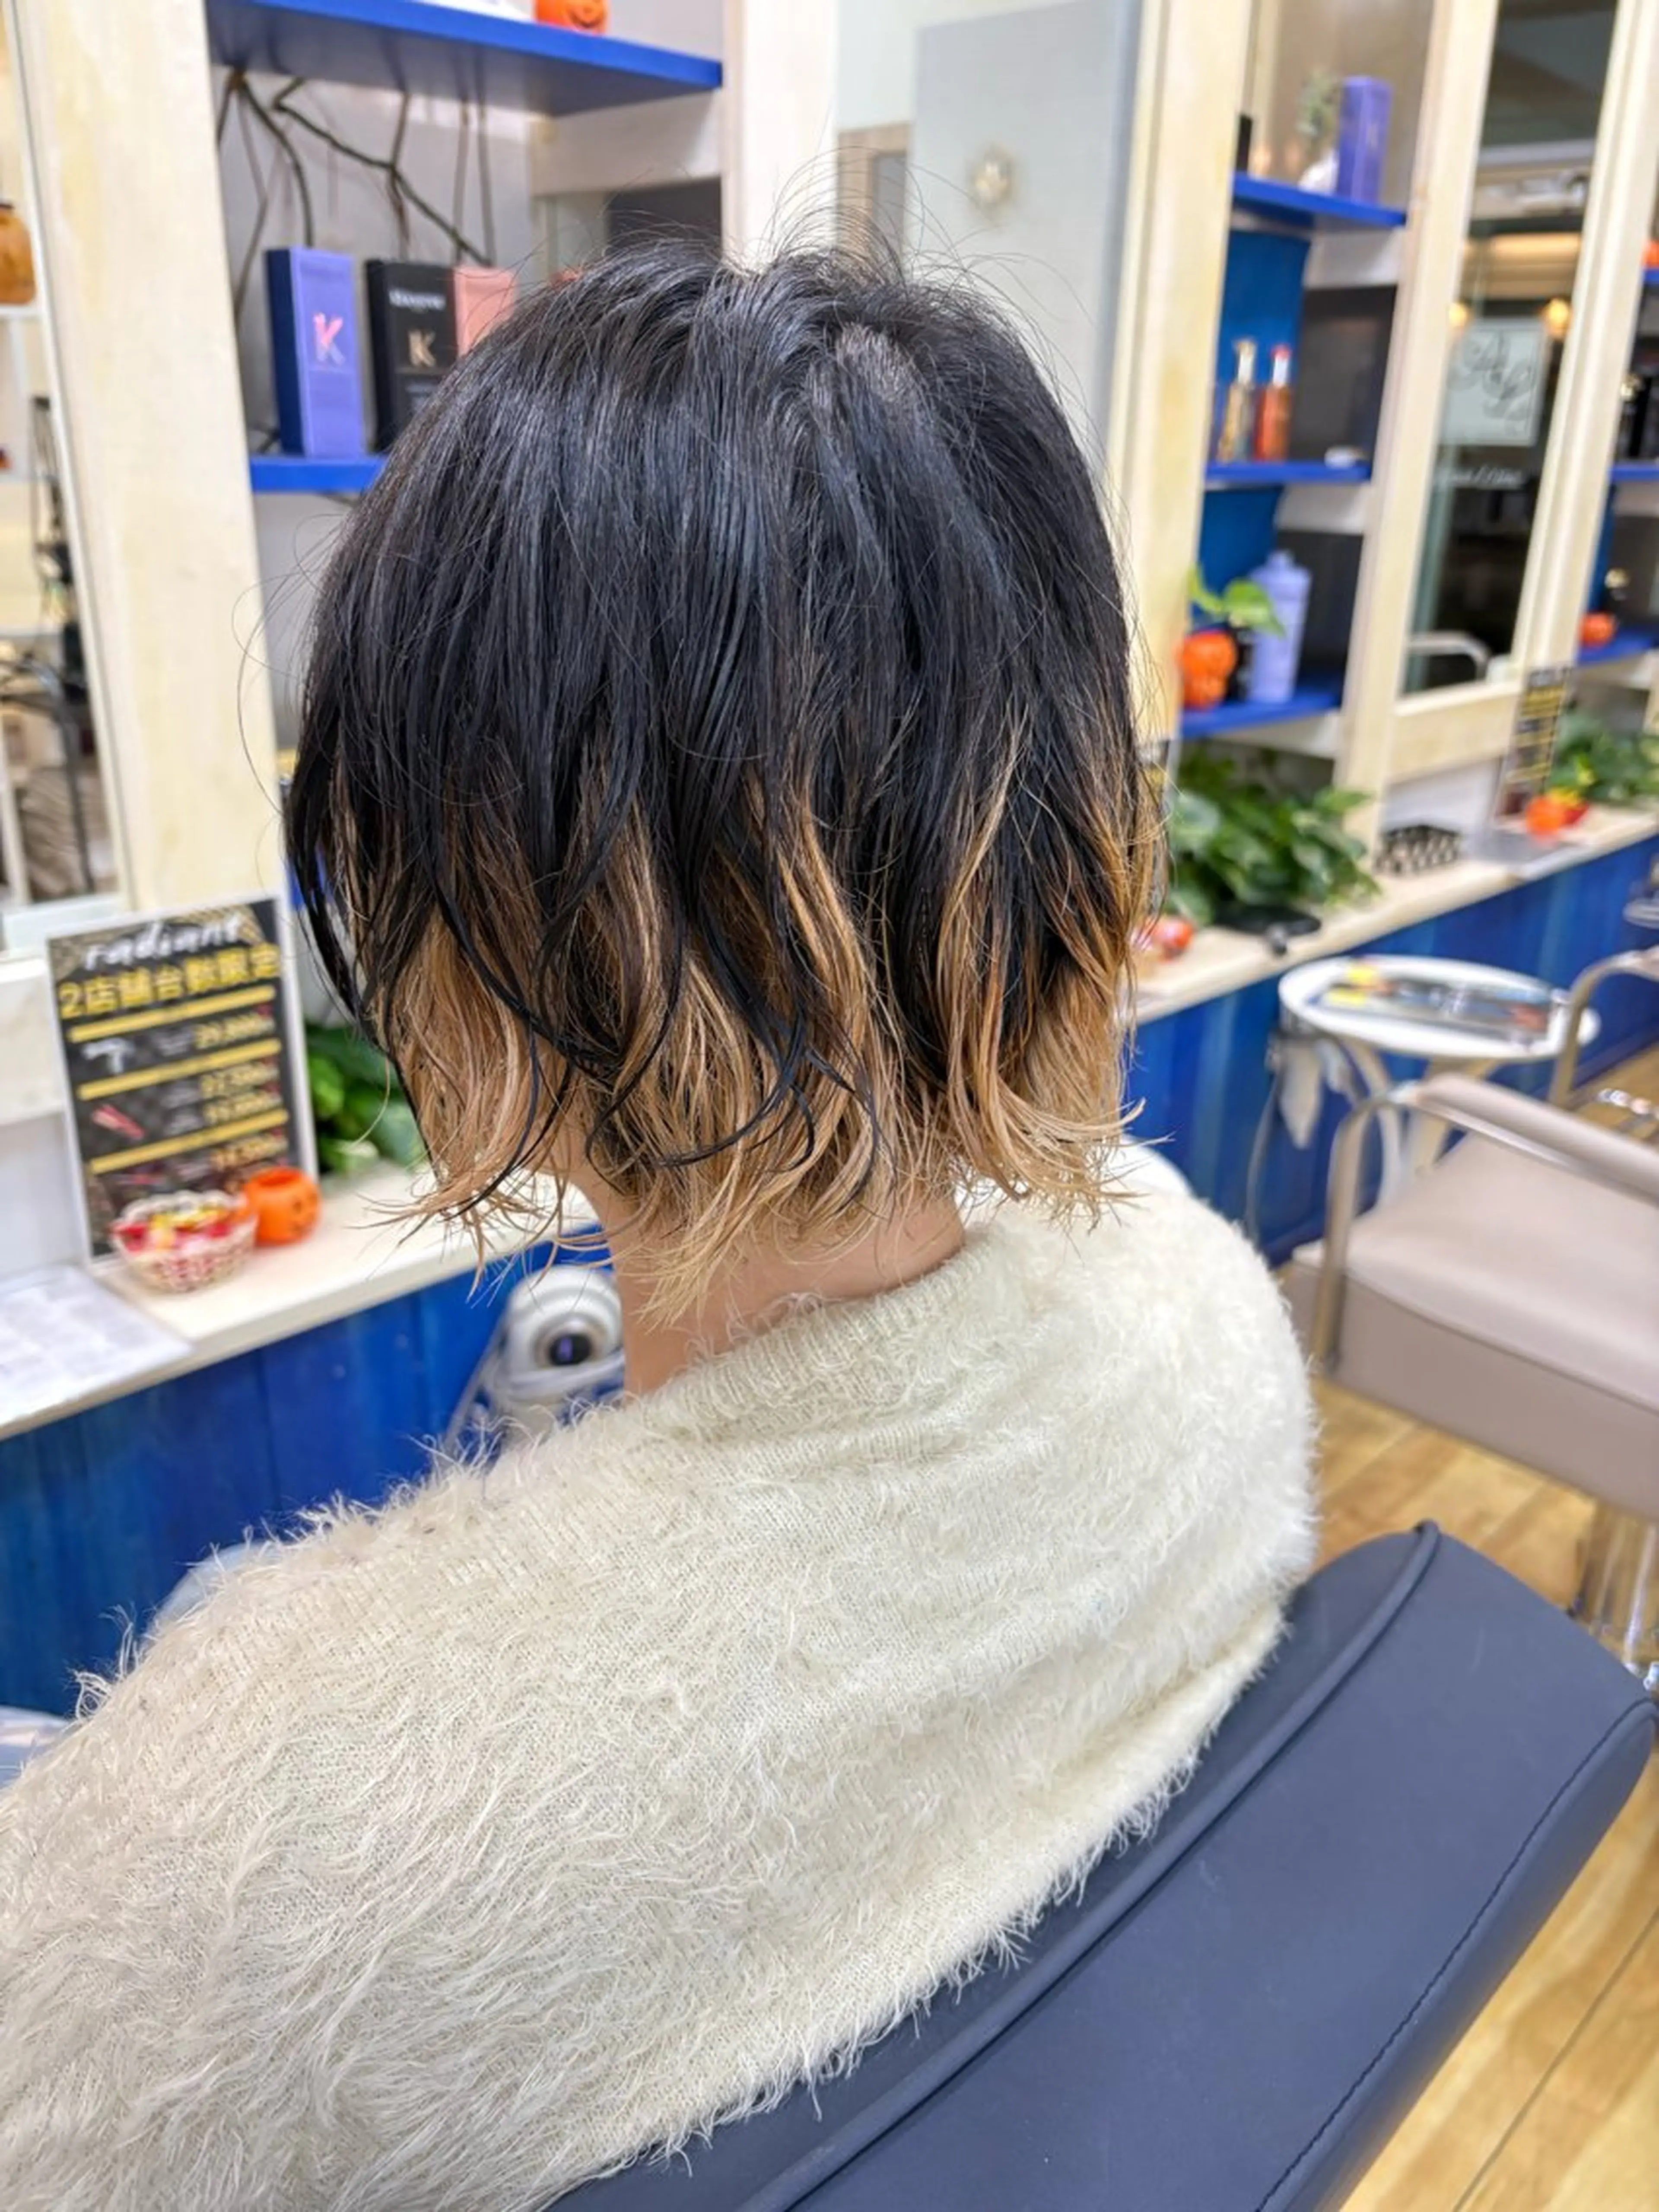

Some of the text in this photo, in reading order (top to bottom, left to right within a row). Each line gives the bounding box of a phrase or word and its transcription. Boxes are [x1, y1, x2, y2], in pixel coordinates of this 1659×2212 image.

[314, 312, 344, 363] K
[408, 331, 436, 367] K
[85, 914, 242, 970] radiant
